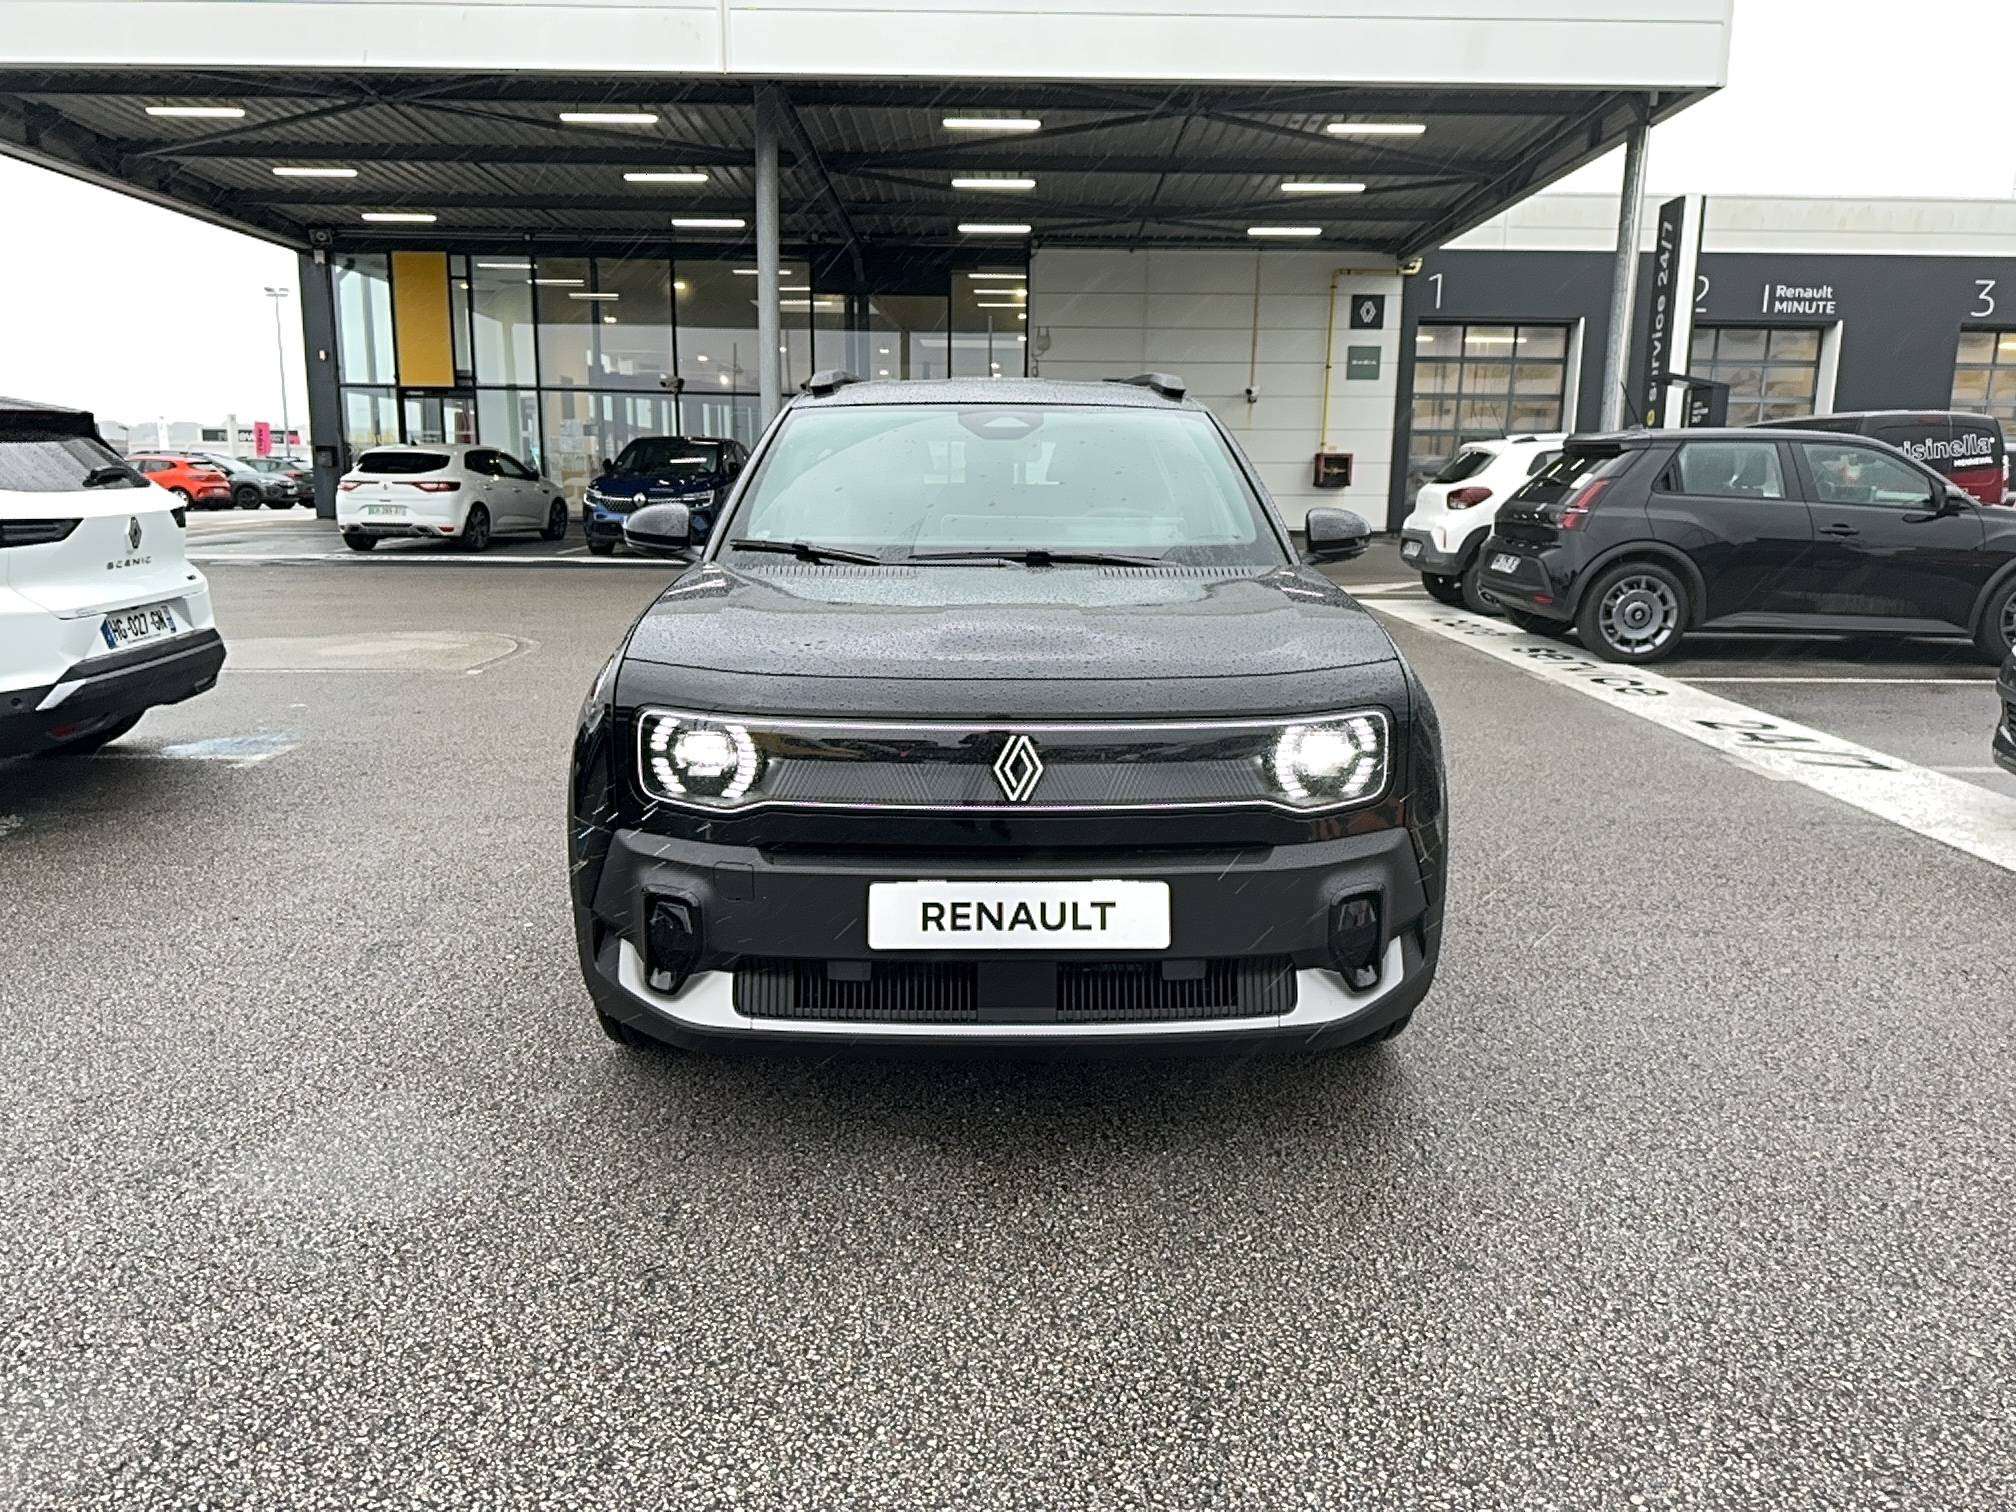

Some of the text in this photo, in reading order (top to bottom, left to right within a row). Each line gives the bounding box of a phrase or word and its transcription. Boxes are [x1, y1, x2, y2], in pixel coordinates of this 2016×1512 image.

[1657, 220, 1674, 286] 24/7
[1428, 273, 1443, 309] 1
[1695, 275, 1710, 313] 2
[1773, 301, 1837, 315] MINUTE
[1775, 284, 1834, 299] Renault
[1969, 279, 1997, 318] 3
[1895, 433, 1992, 460] isinella
[1689, 718, 1904, 773] 24/7
[921, 901, 1117, 932] RENAULT
